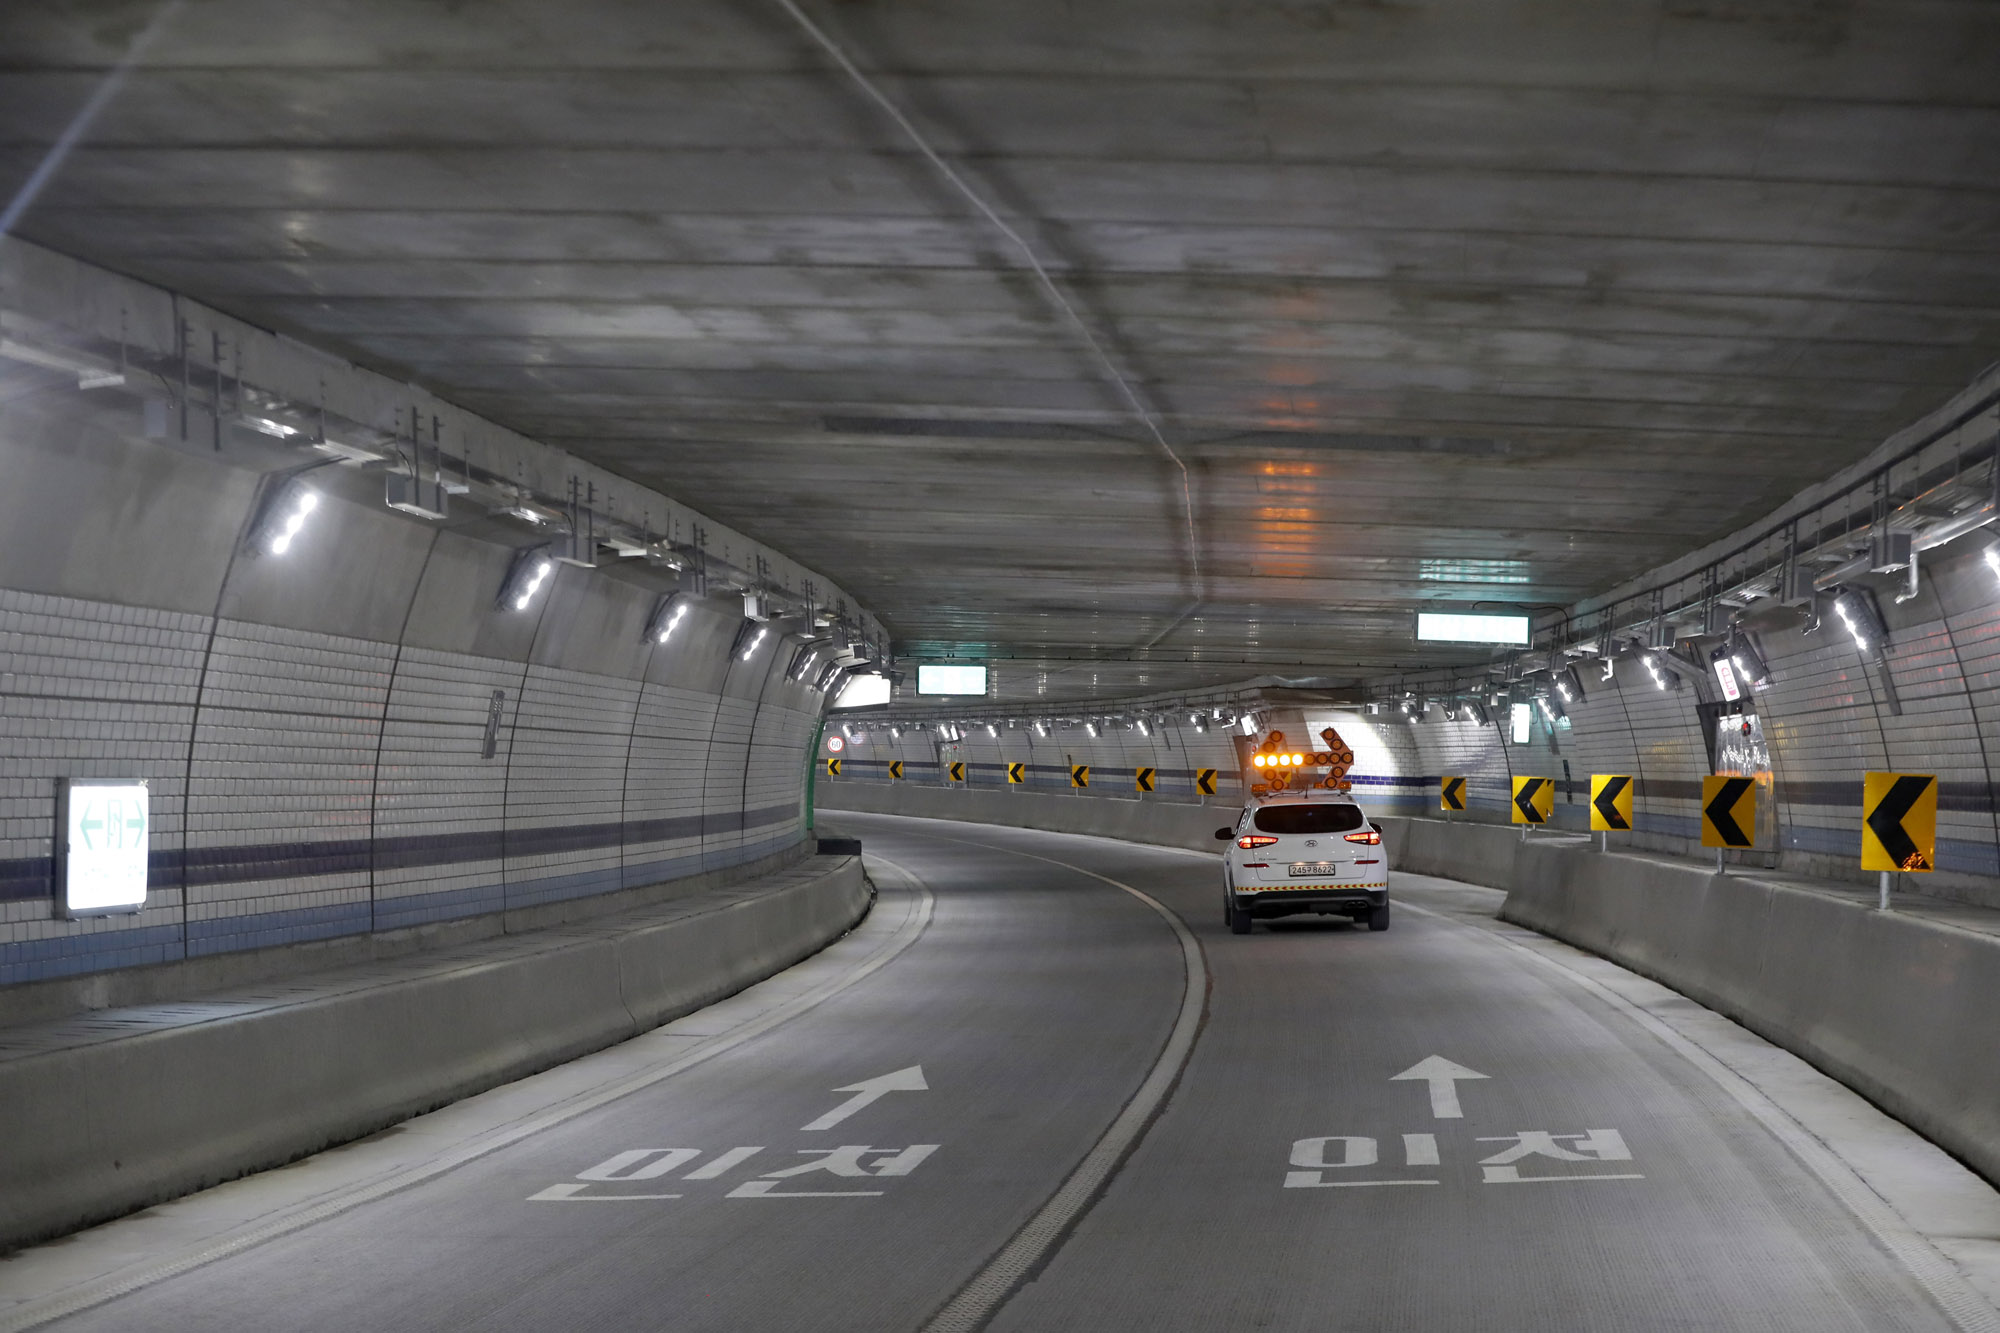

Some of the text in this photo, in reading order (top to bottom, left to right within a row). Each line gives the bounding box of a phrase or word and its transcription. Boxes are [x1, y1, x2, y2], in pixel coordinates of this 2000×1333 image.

[831, 740, 841, 749] 60
[525, 1144, 941, 1200] 인천
[1283, 1128, 1646, 1188] 인천
